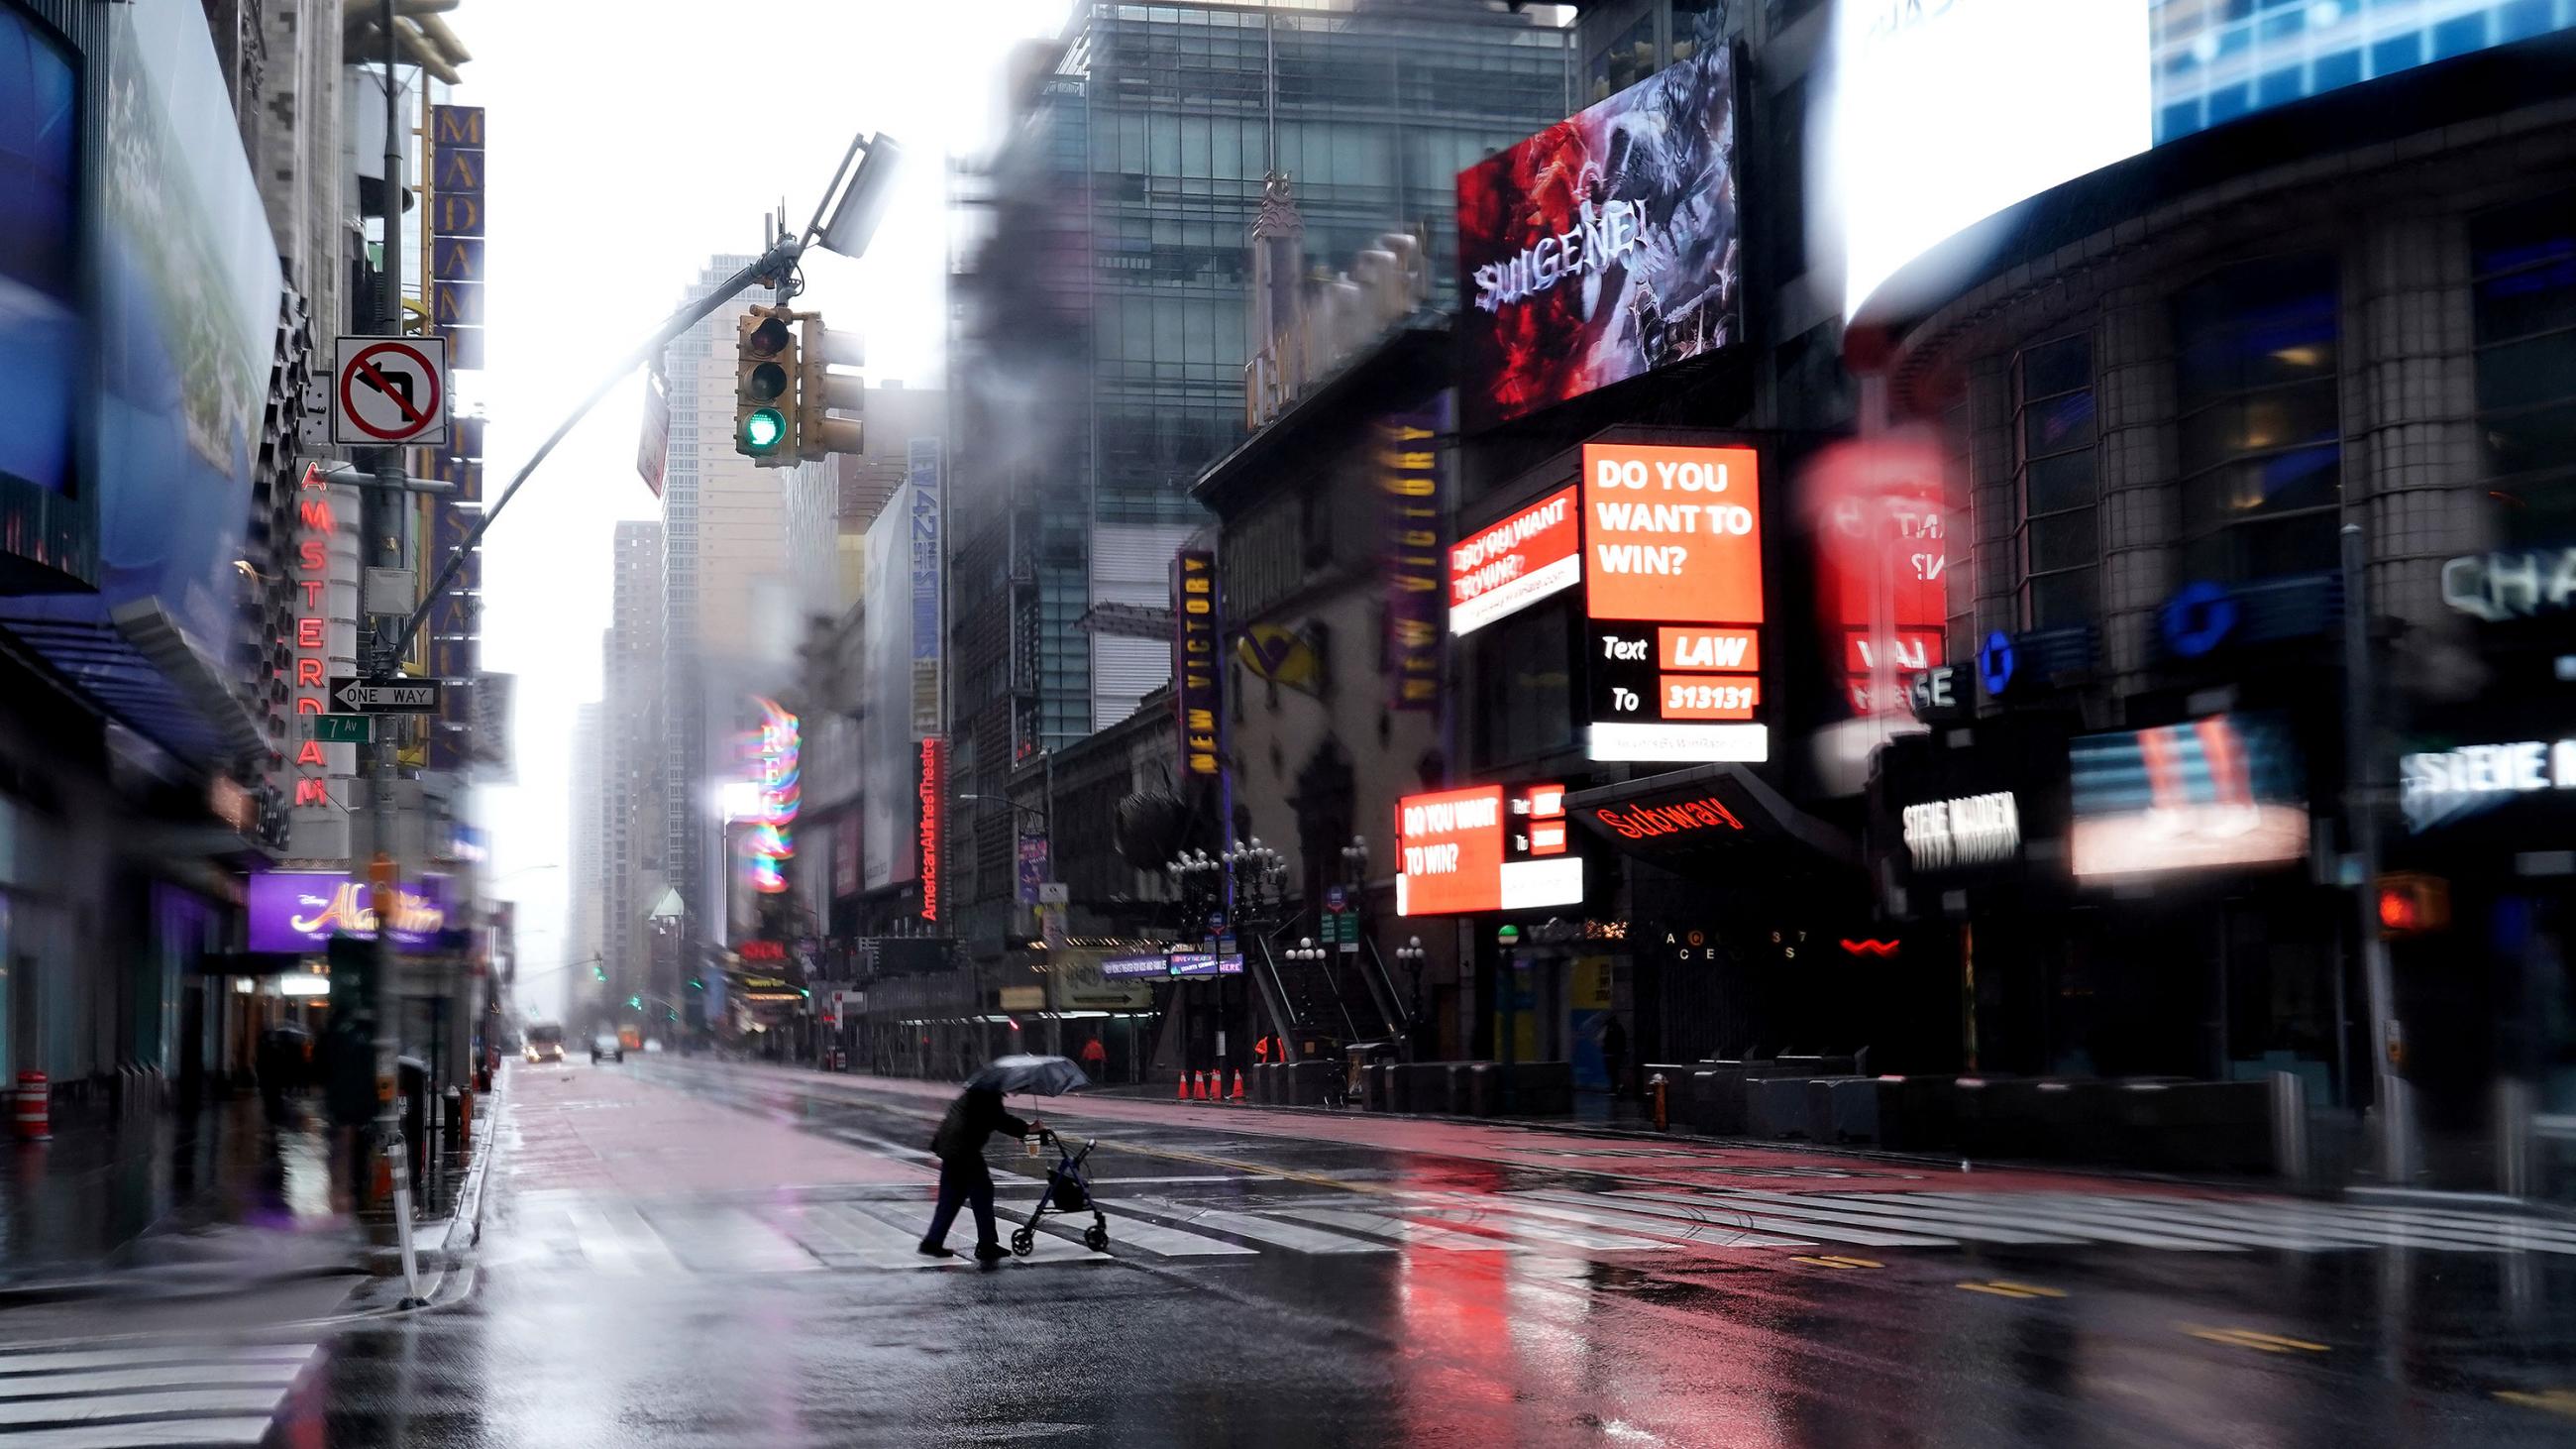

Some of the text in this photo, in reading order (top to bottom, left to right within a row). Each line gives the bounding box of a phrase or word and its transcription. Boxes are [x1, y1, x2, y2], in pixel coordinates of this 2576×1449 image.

[1597, 459, 1728, 493] DO YOU
[1477, 524, 1519, 558] YOU
[1512, 498, 1567, 540] WANT
[1596, 502, 1753, 535] WANT TO
[1597, 544, 1688, 576] WIN?
[295, 462, 334, 808] AMSTERDAM
[1603, 635, 1748, 668] Text LAW
[1185, 558, 1218, 774] VICTORY NEW
[347, 688, 427, 703] ONE WAY
[1612, 684, 1753, 712] To 313131
[329, 719, 339, 738] 7
[1404, 806, 1426, 837] DO
[1426, 803, 1454, 833] YOU
[1596, 797, 1744, 839] Subway
[1405, 842, 1459, 875] TO WIN?
[1665, 933, 1675, 944] A
[1679, 947, 1795, 959] C E S
